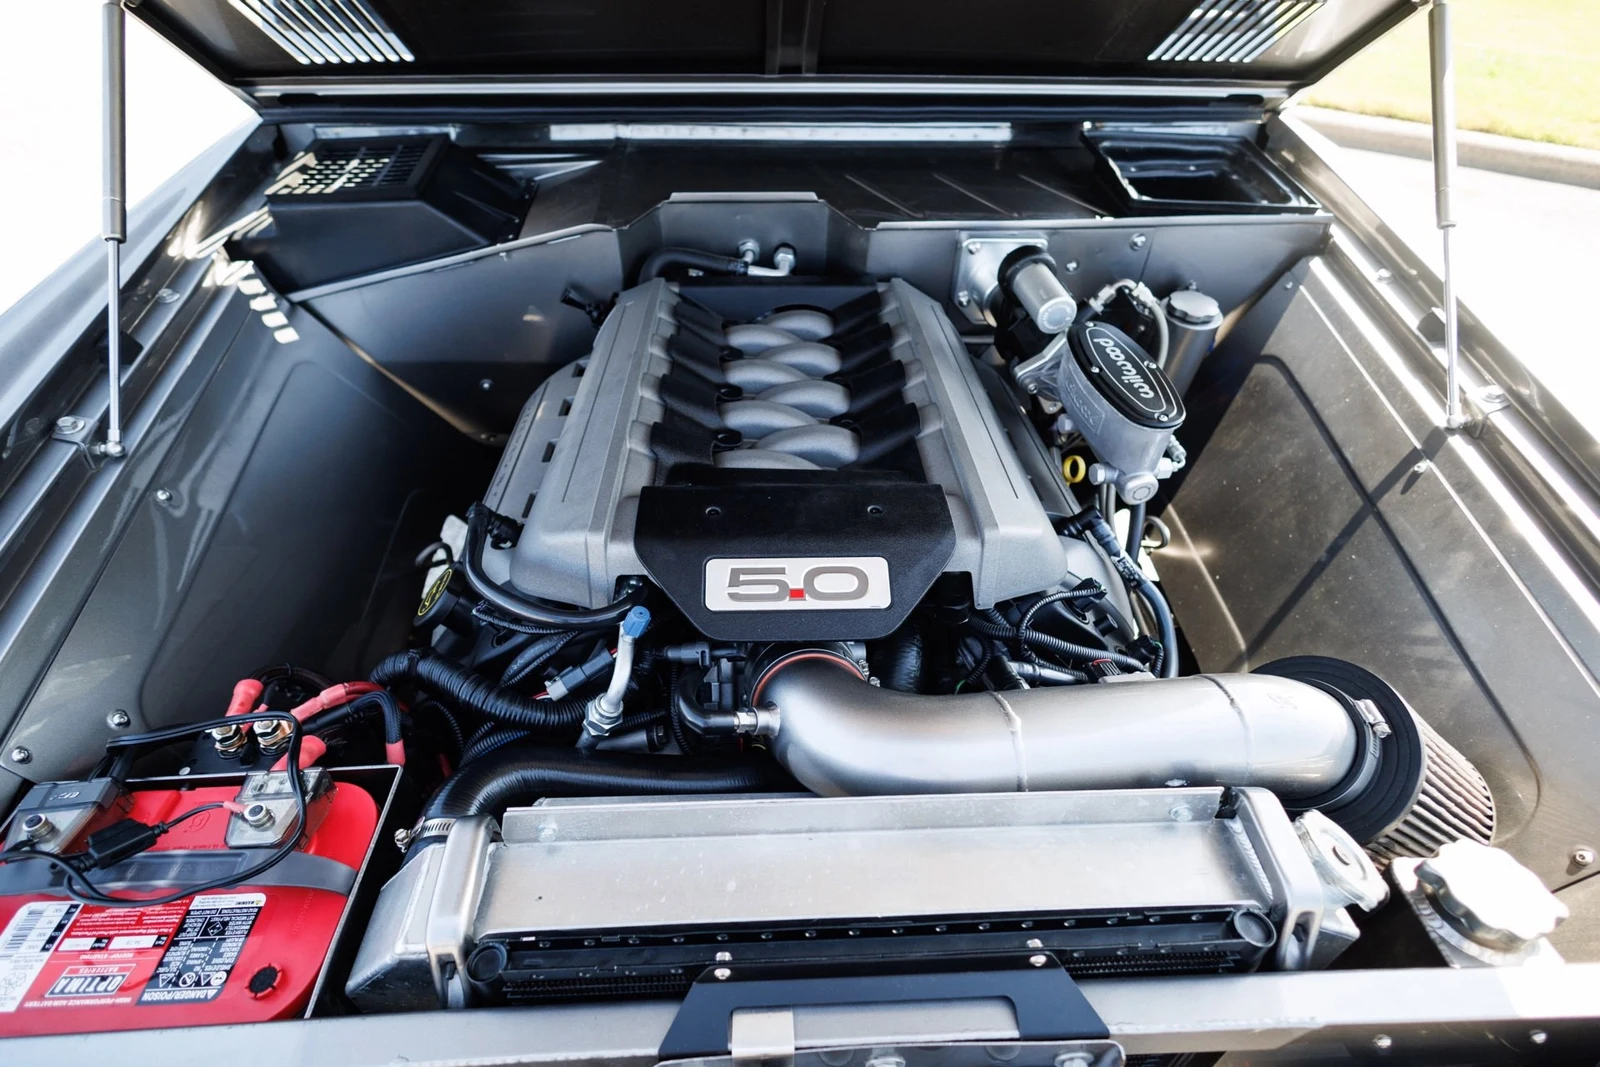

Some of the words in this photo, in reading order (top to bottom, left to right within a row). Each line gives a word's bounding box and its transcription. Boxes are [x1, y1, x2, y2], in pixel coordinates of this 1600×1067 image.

[1093, 337, 1155, 399] wilwood
[727, 566, 869, 602] 5.0
[53, 975, 123, 993] OPTIMA
[141, 990, 208, 1000] DANGER/POISON
